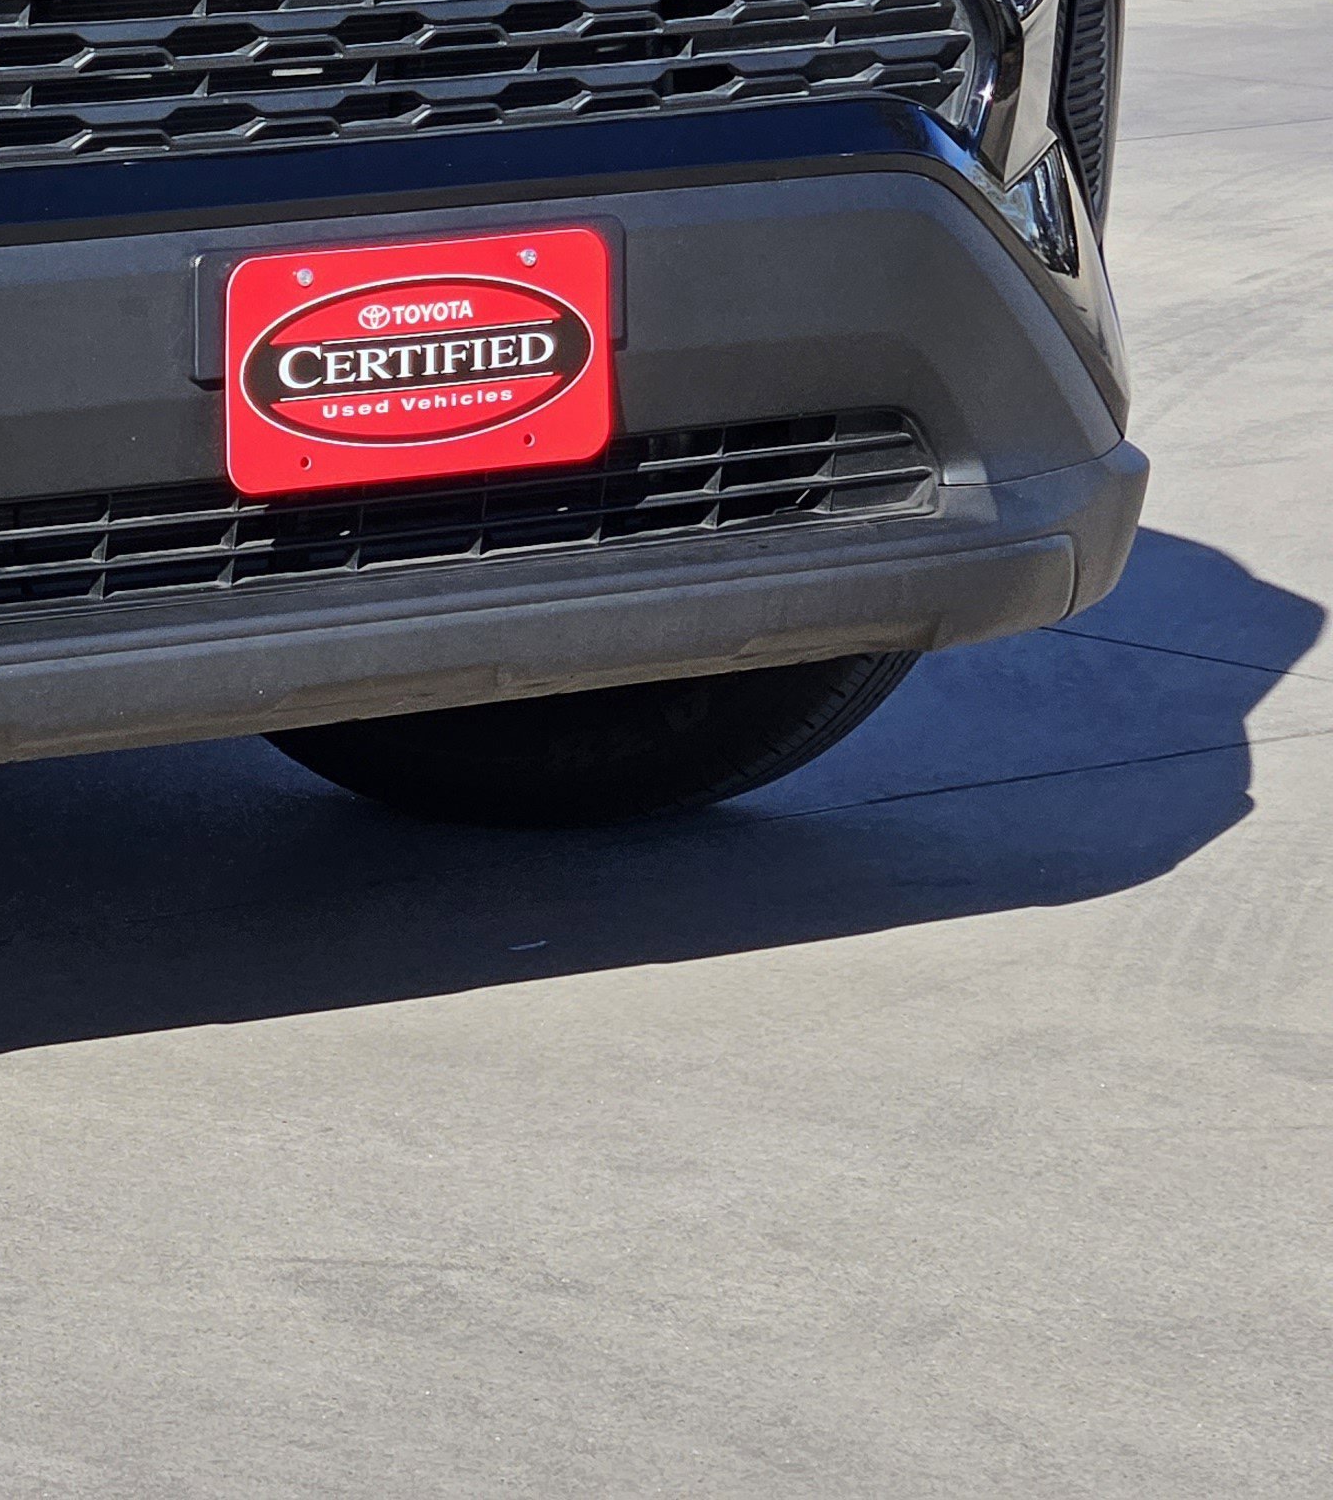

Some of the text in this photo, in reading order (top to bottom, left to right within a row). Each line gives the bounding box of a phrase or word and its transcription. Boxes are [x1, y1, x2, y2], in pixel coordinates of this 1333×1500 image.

[391, 299, 474, 326] TOYOTA
[278, 331, 555, 389] CERTIFIED
[322, 389, 514, 420] Used Vehicles
